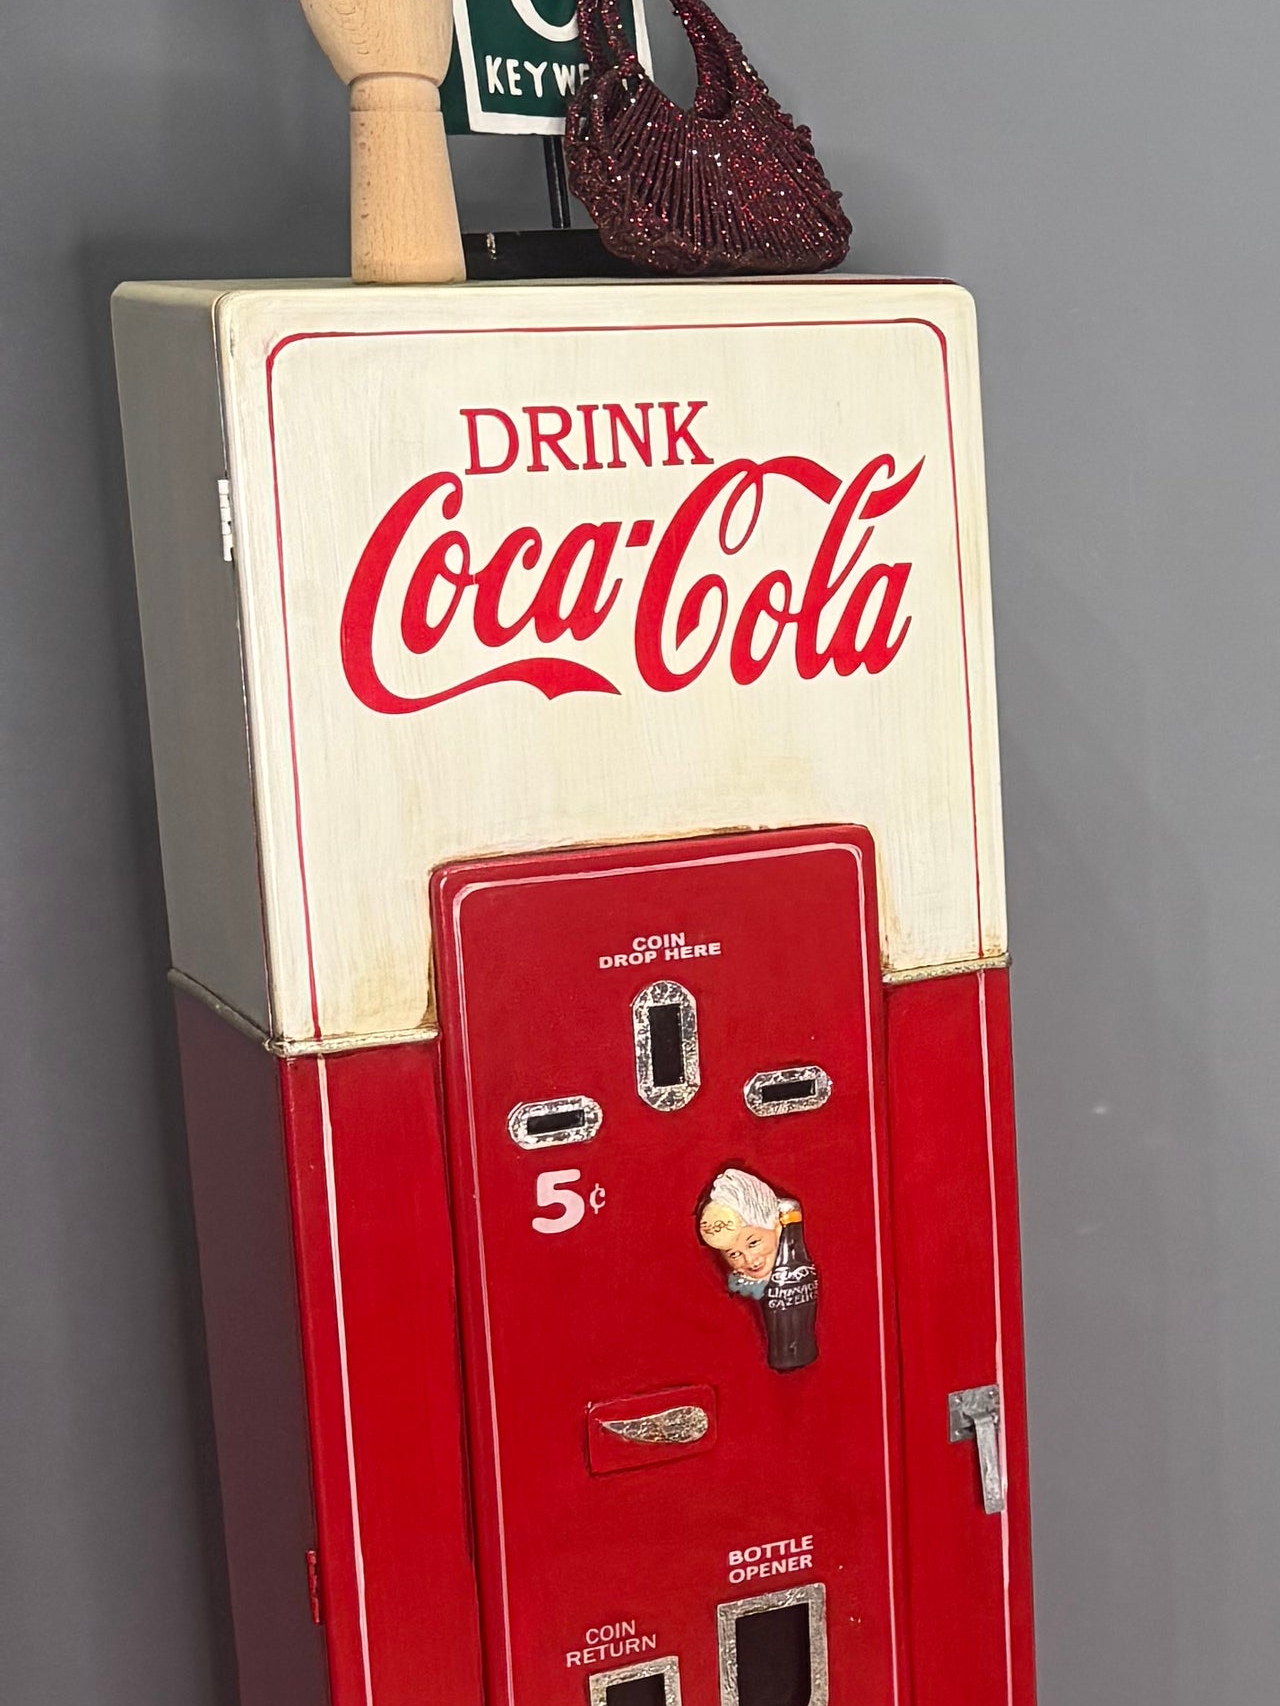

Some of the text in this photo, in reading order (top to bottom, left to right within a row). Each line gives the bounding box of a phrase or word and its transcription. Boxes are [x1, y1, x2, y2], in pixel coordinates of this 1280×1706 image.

[459, 400, 714, 475] DRINK
[340, 454, 926, 715] Coca-Cola
[598, 941, 722, 970] DROP HERE
[632, 932, 686, 952] COIN
[728, 1535, 814, 1566] BOTTLE
[729, 1554, 812, 1584] OPENER
[585, 1620, 636, 1645] COIN
[566, 1634, 657, 1668] RETURN
